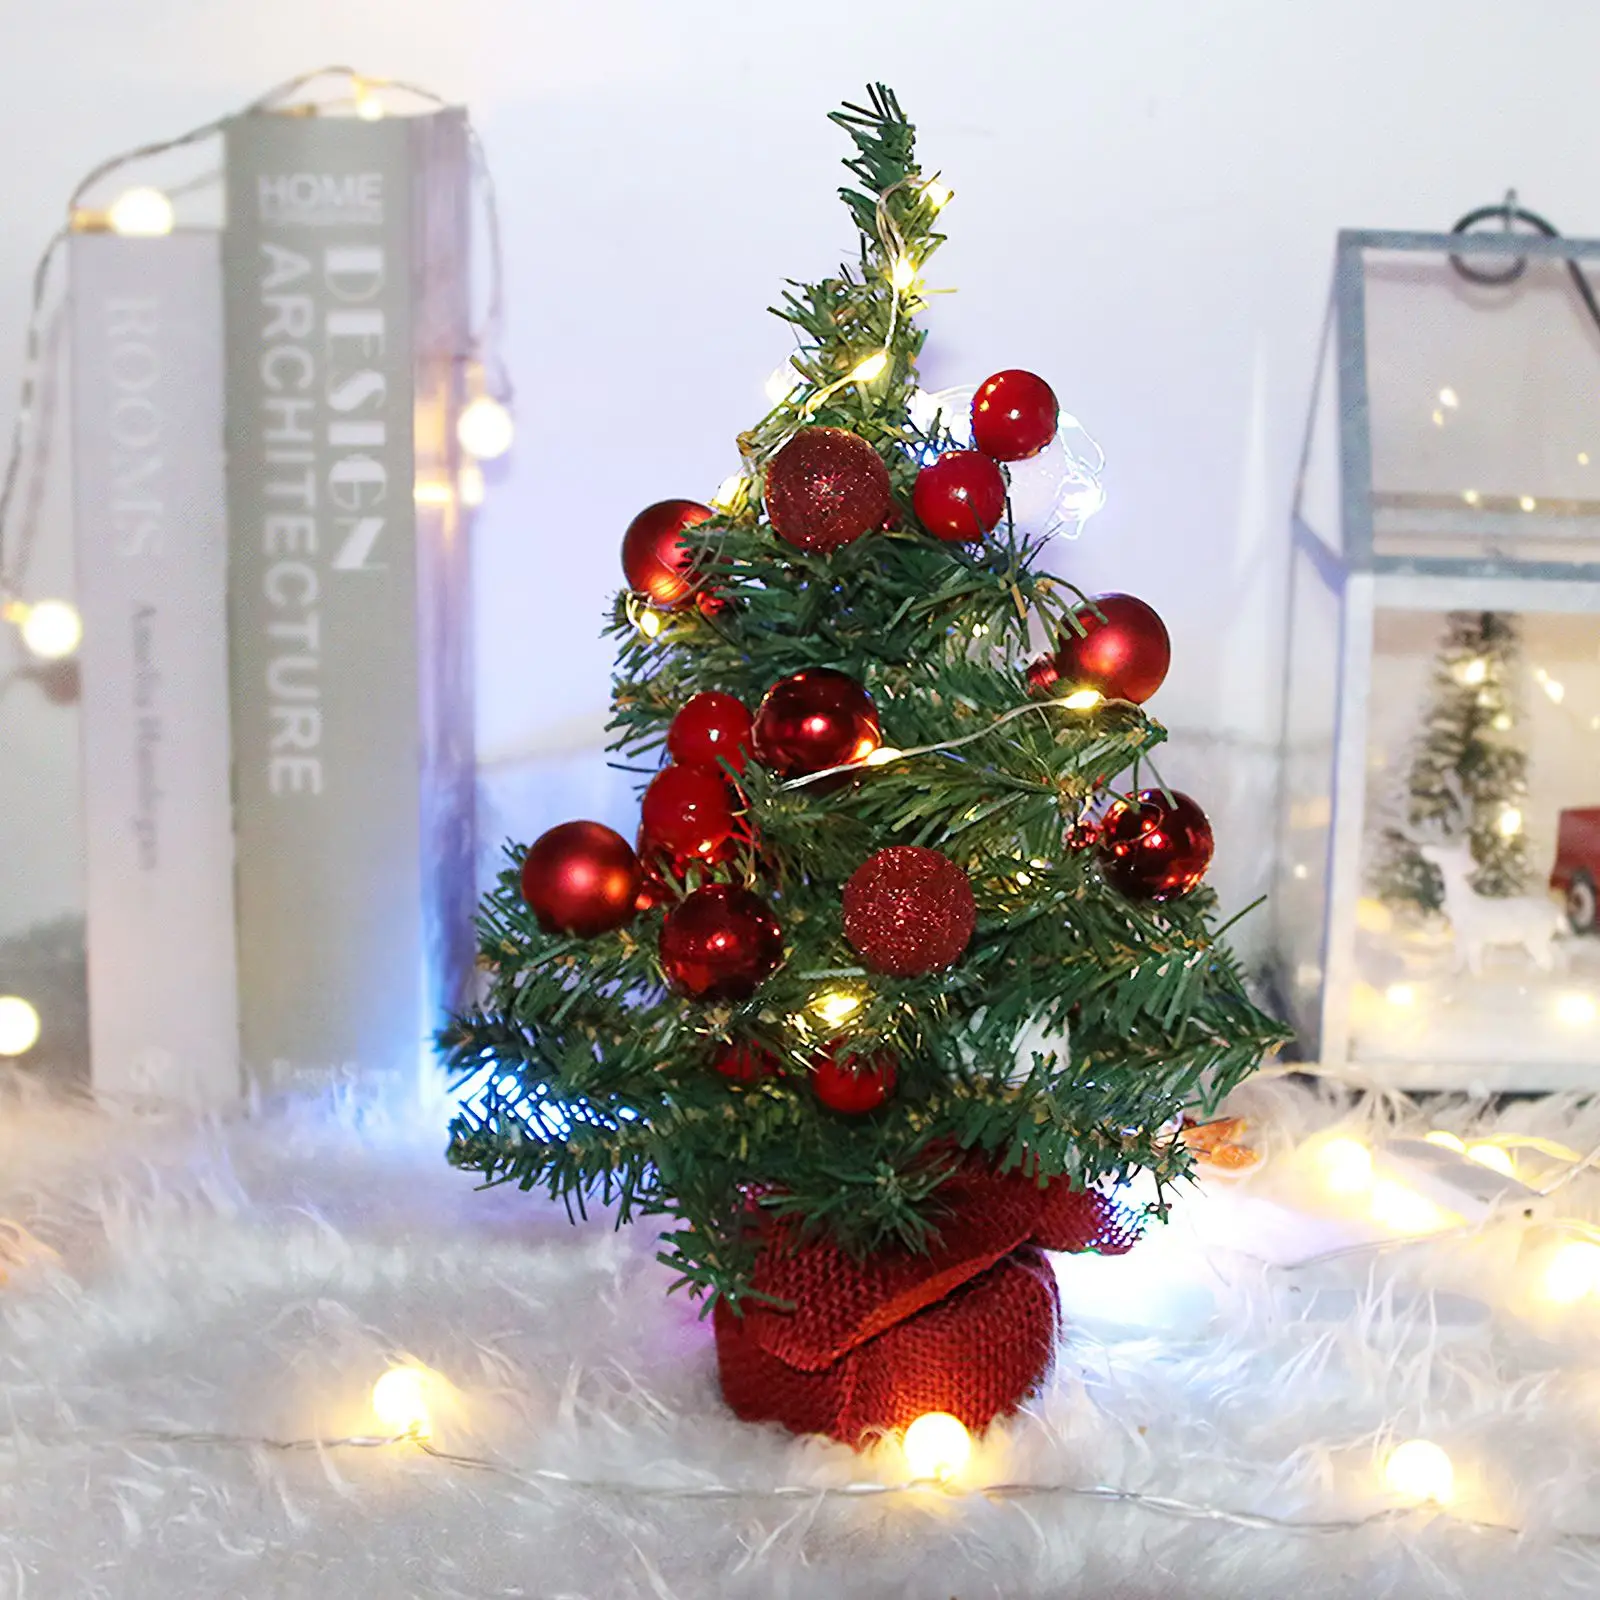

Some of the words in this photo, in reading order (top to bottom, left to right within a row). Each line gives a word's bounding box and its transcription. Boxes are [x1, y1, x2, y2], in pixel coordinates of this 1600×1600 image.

[257, 172, 384, 206] HOME
[259, 243, 323, 795] ARCHITECTURE
[324, 246, 388, 570] DESIGN
